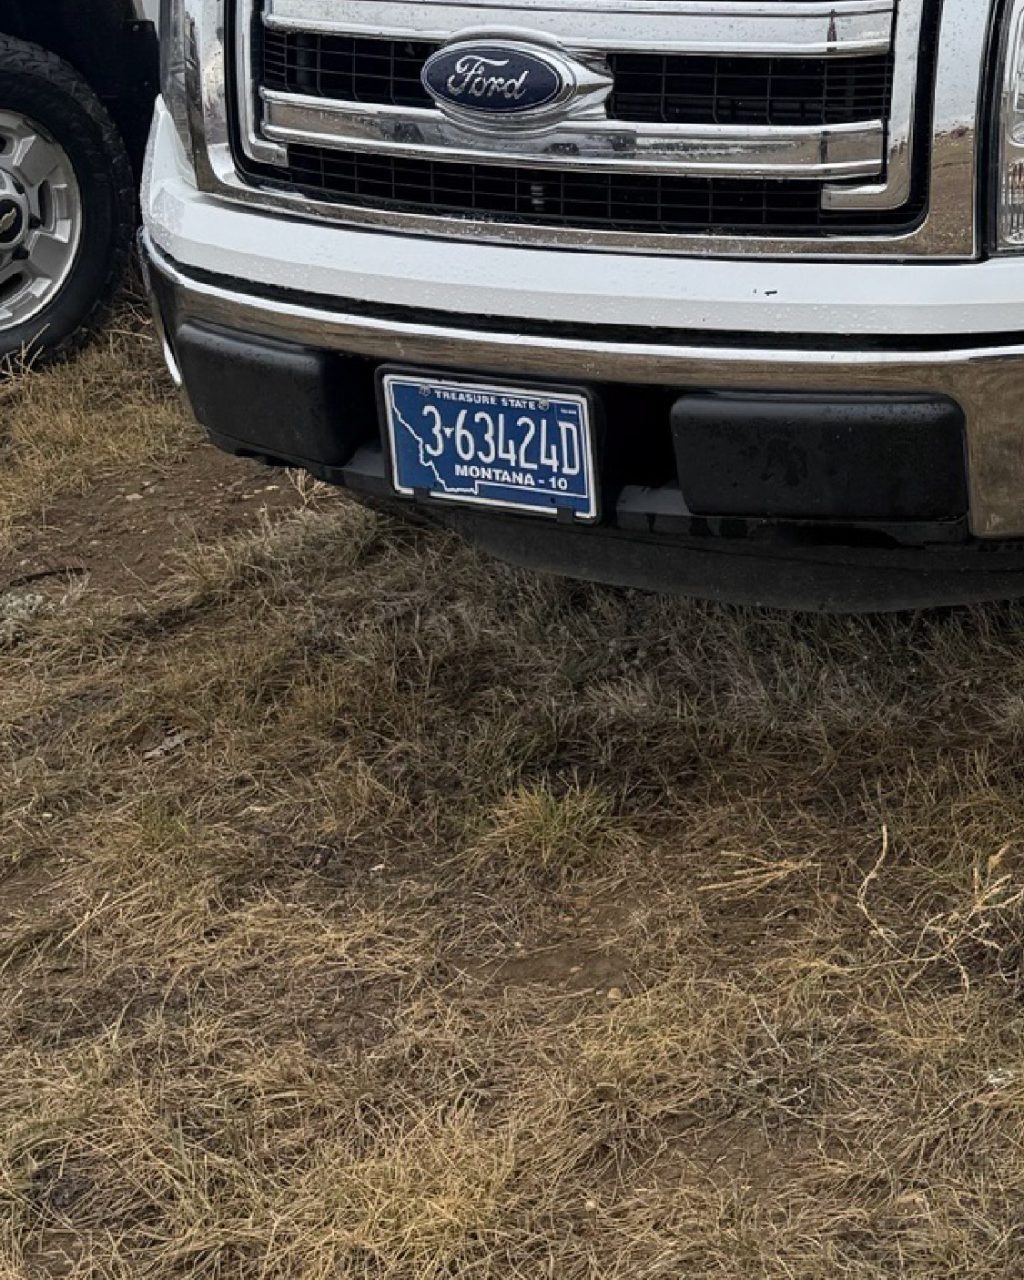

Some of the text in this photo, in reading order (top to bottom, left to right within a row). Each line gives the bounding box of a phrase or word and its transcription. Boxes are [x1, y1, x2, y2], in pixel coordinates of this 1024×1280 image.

[446, 55, 530, 99] Ford
[434, 391, 536, 410] TREASURE STATE
[454, 464, 535, 487] MONTANA
[548, 475, 568, 491] 10
